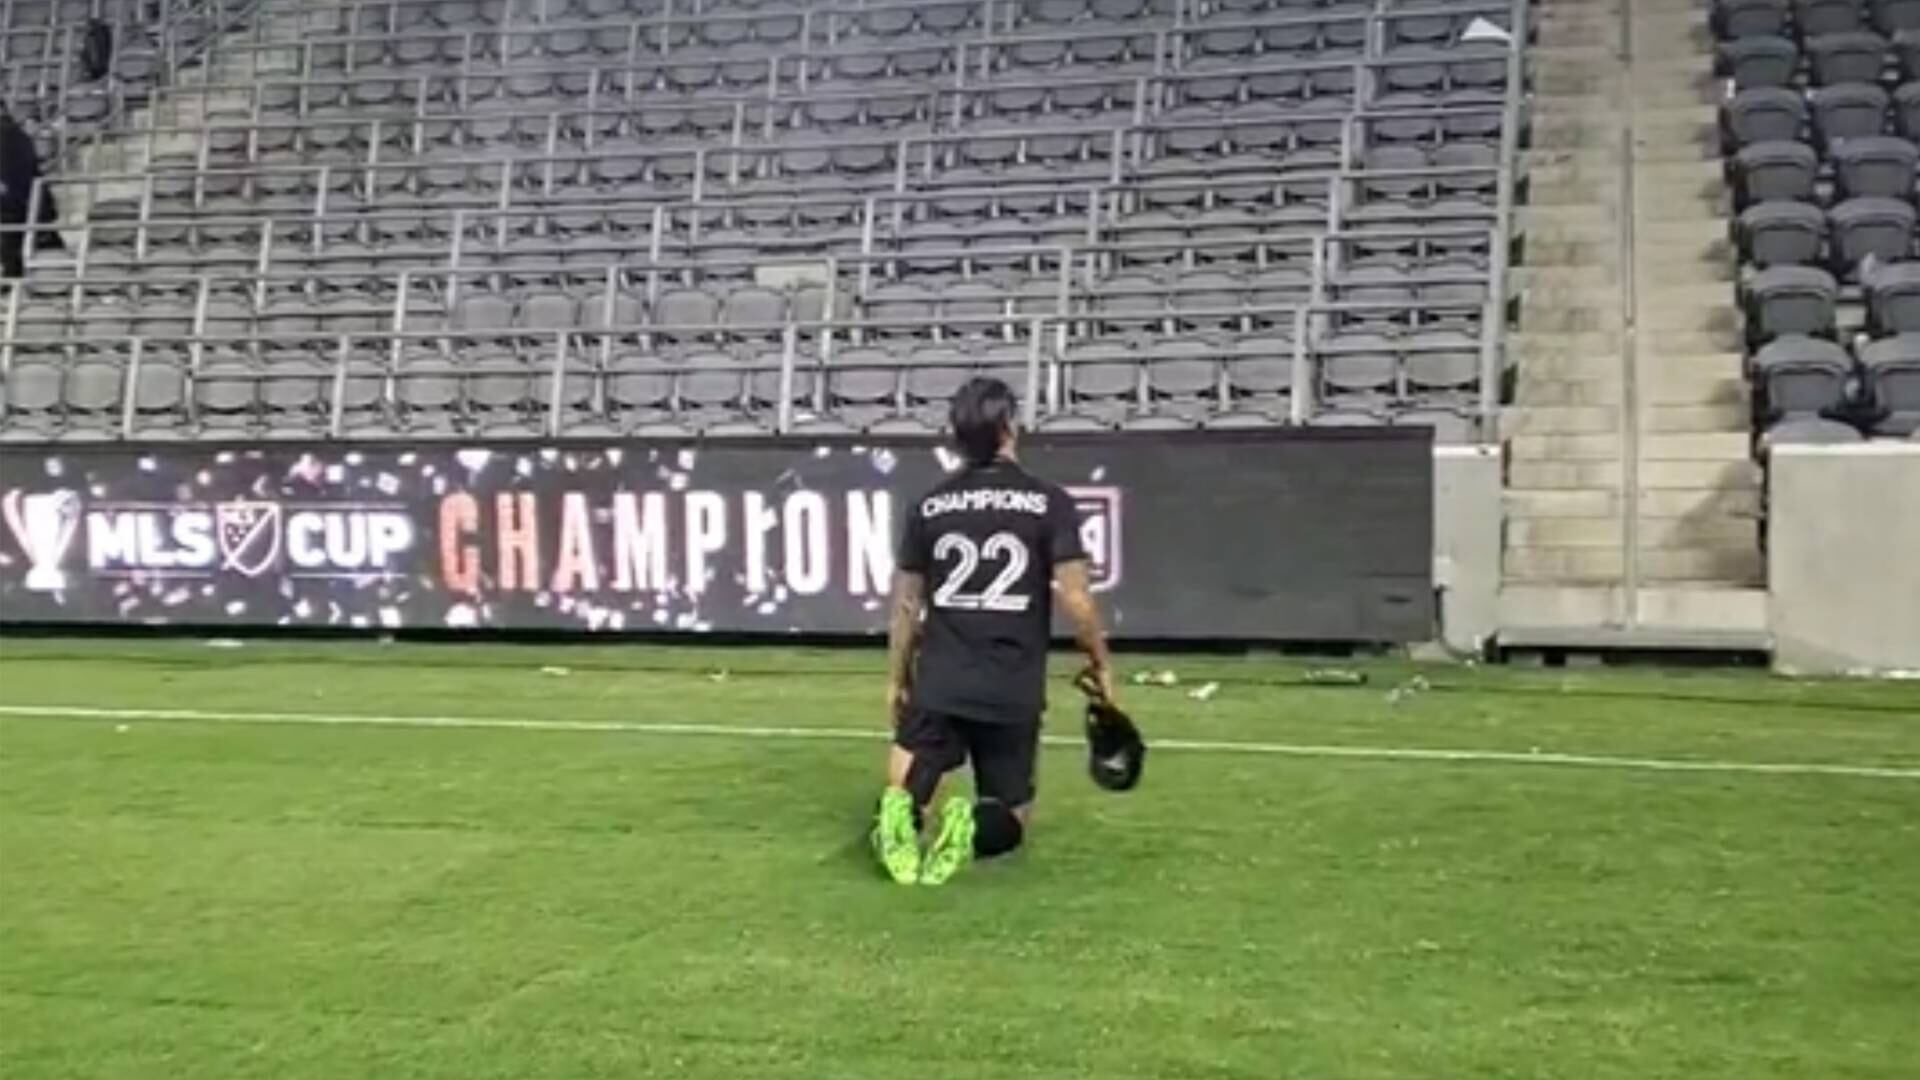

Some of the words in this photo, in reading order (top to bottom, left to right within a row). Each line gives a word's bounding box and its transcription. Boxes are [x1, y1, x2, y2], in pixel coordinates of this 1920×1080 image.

[922, 489, 1048, 518] CHAMPIONS
[86, 511, 217, 569] MLS
[286, 511, 412, 567] CUP
[439, 490, 894, 596] CHAMPION
[933, 532, 1031, 611] 22
